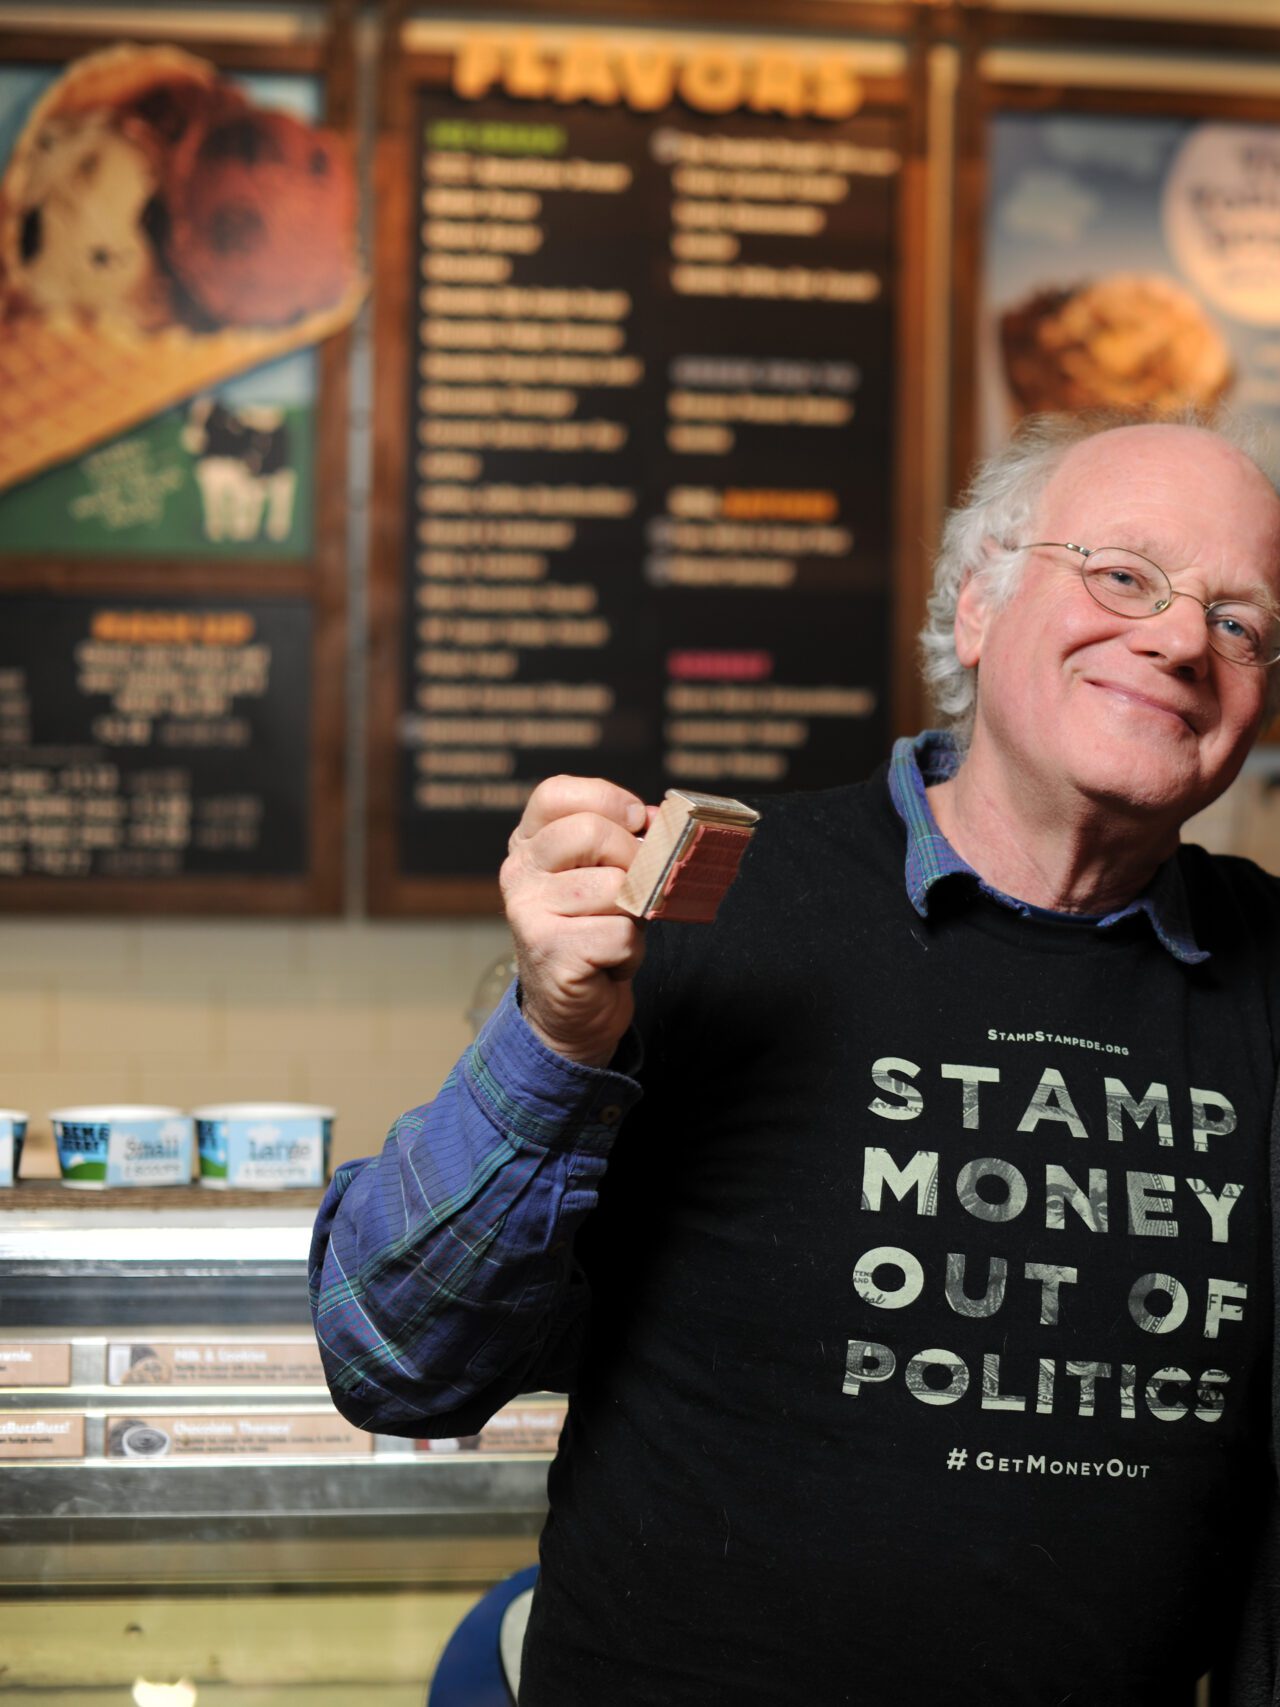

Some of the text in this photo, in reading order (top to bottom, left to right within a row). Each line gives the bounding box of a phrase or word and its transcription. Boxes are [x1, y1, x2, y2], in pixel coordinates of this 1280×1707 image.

[124, 1136, 180, 1161] Small
[867, 1056, 1239, 1152] STAMP
[860, 1146, 1245, 1243] MONEY
[853, 1246, 1248, 1339] OUT OF
[842, 1339, 1232, 1423] POLITICS
